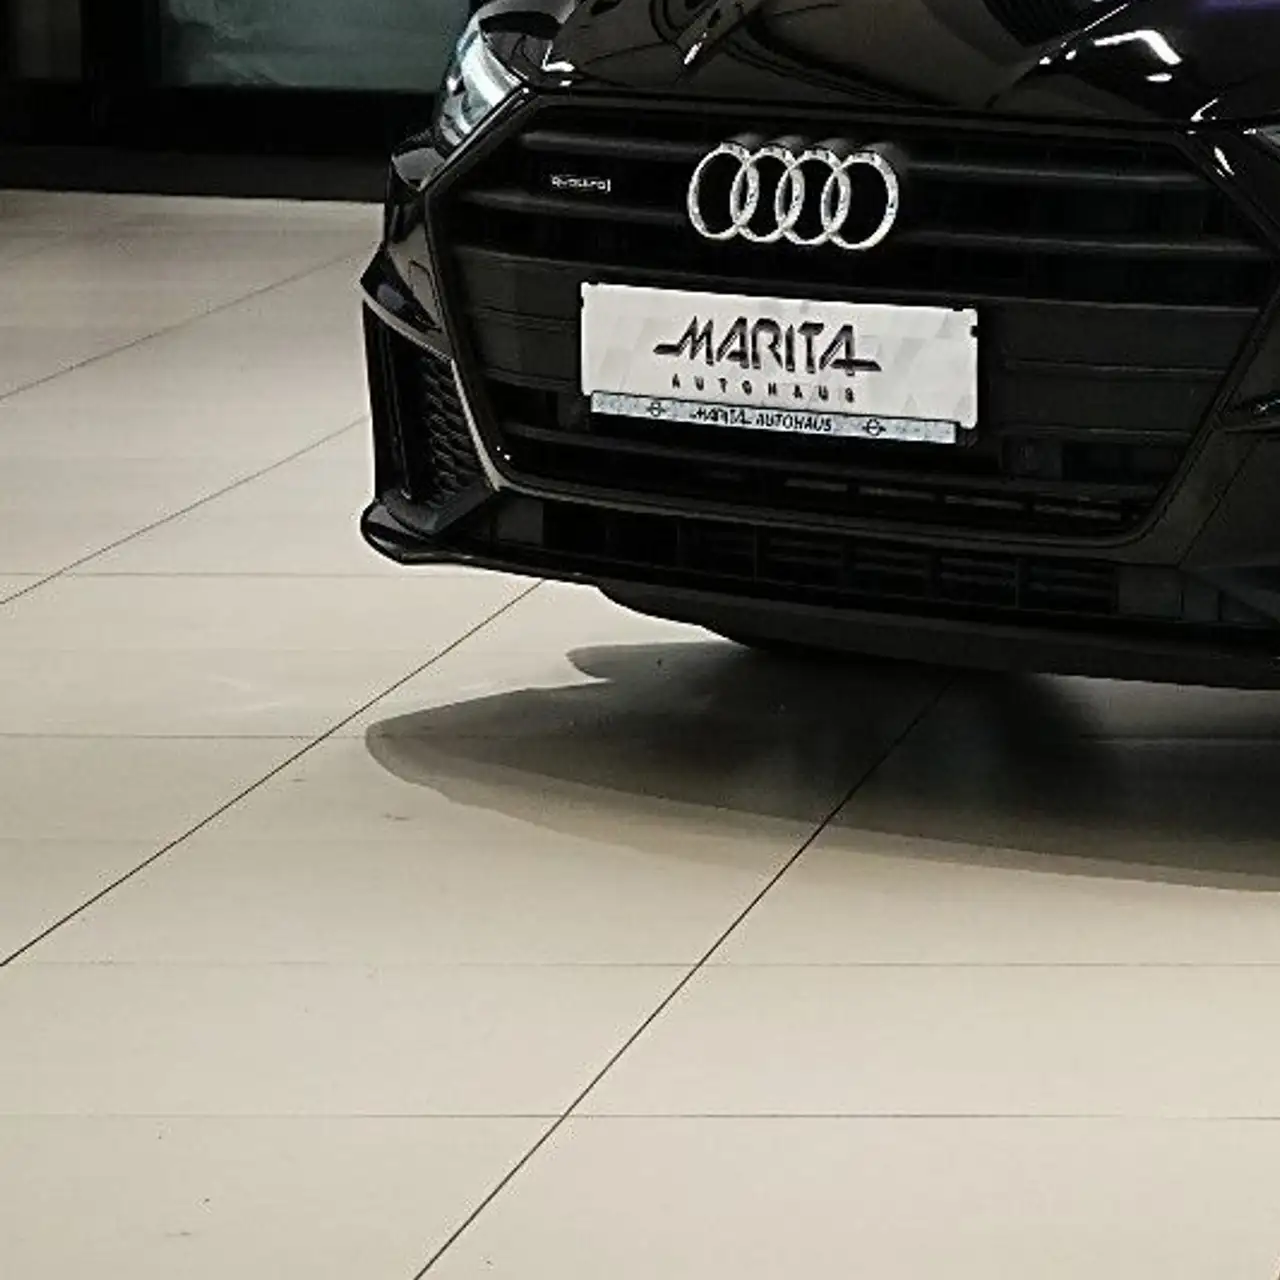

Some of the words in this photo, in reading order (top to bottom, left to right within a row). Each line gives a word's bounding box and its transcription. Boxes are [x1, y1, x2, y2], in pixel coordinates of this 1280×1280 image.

[653, 315, 882, 377] MARITA
[690, 407, 752, 425] MARITA
[755, 411, 833, 433] AUTOHAUS
